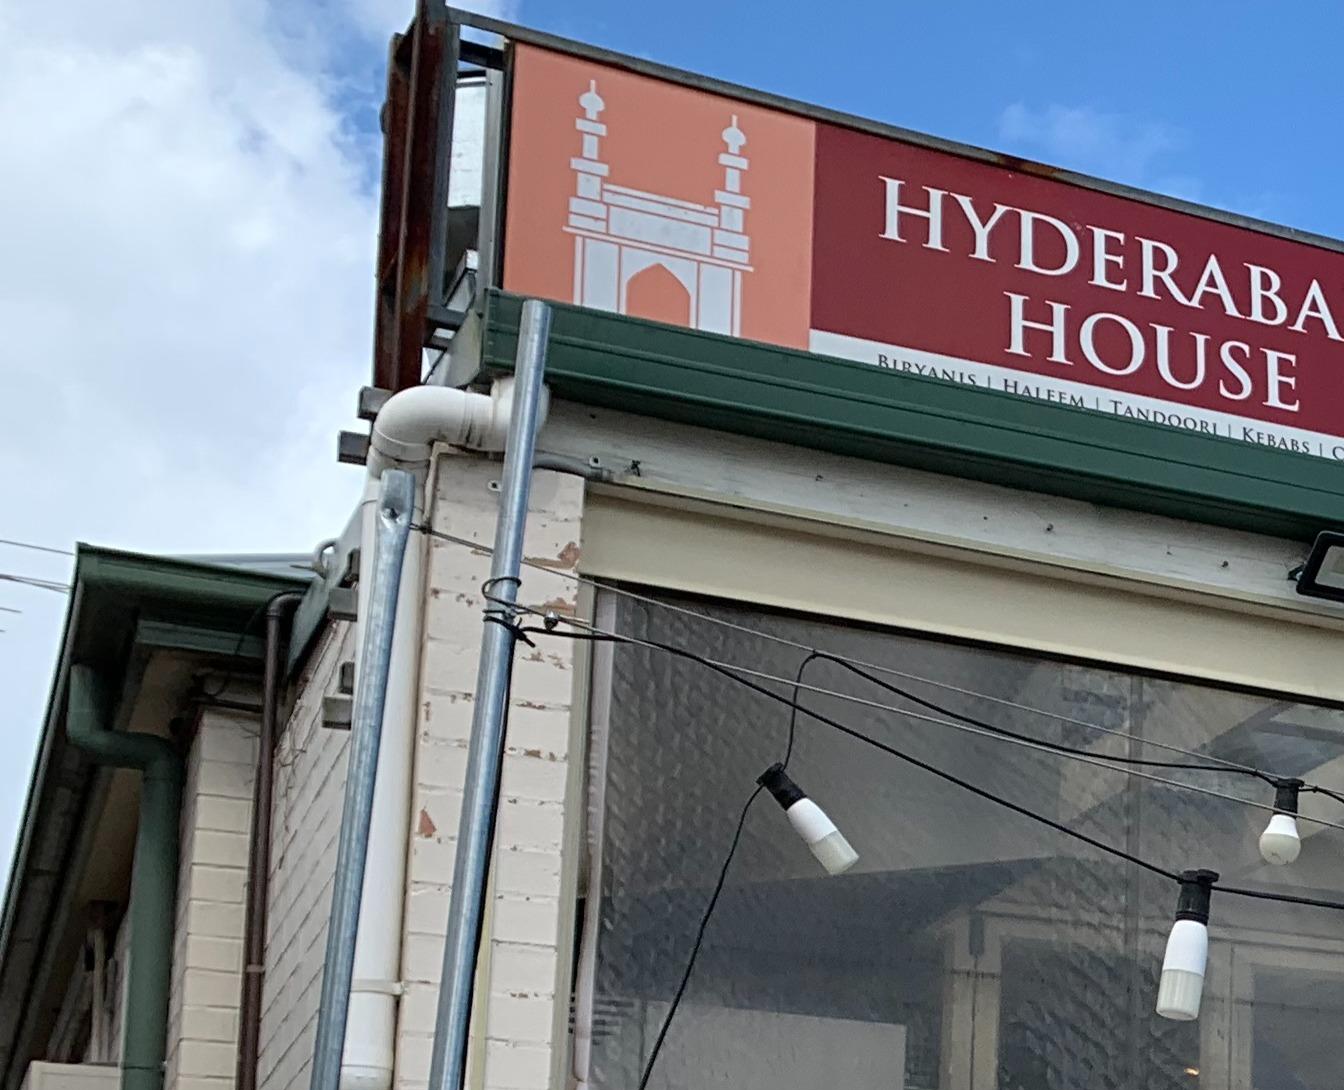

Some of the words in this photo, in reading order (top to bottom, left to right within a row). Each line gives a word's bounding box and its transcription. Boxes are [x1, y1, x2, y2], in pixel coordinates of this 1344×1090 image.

[878, 353, 977, 387] BIRYANIS
[1108, 399, 1218, 435] TANDOORI
[1242, 426, 1310, 454] KEBABS
[1003, 290, 1300, 413] HOUSE
